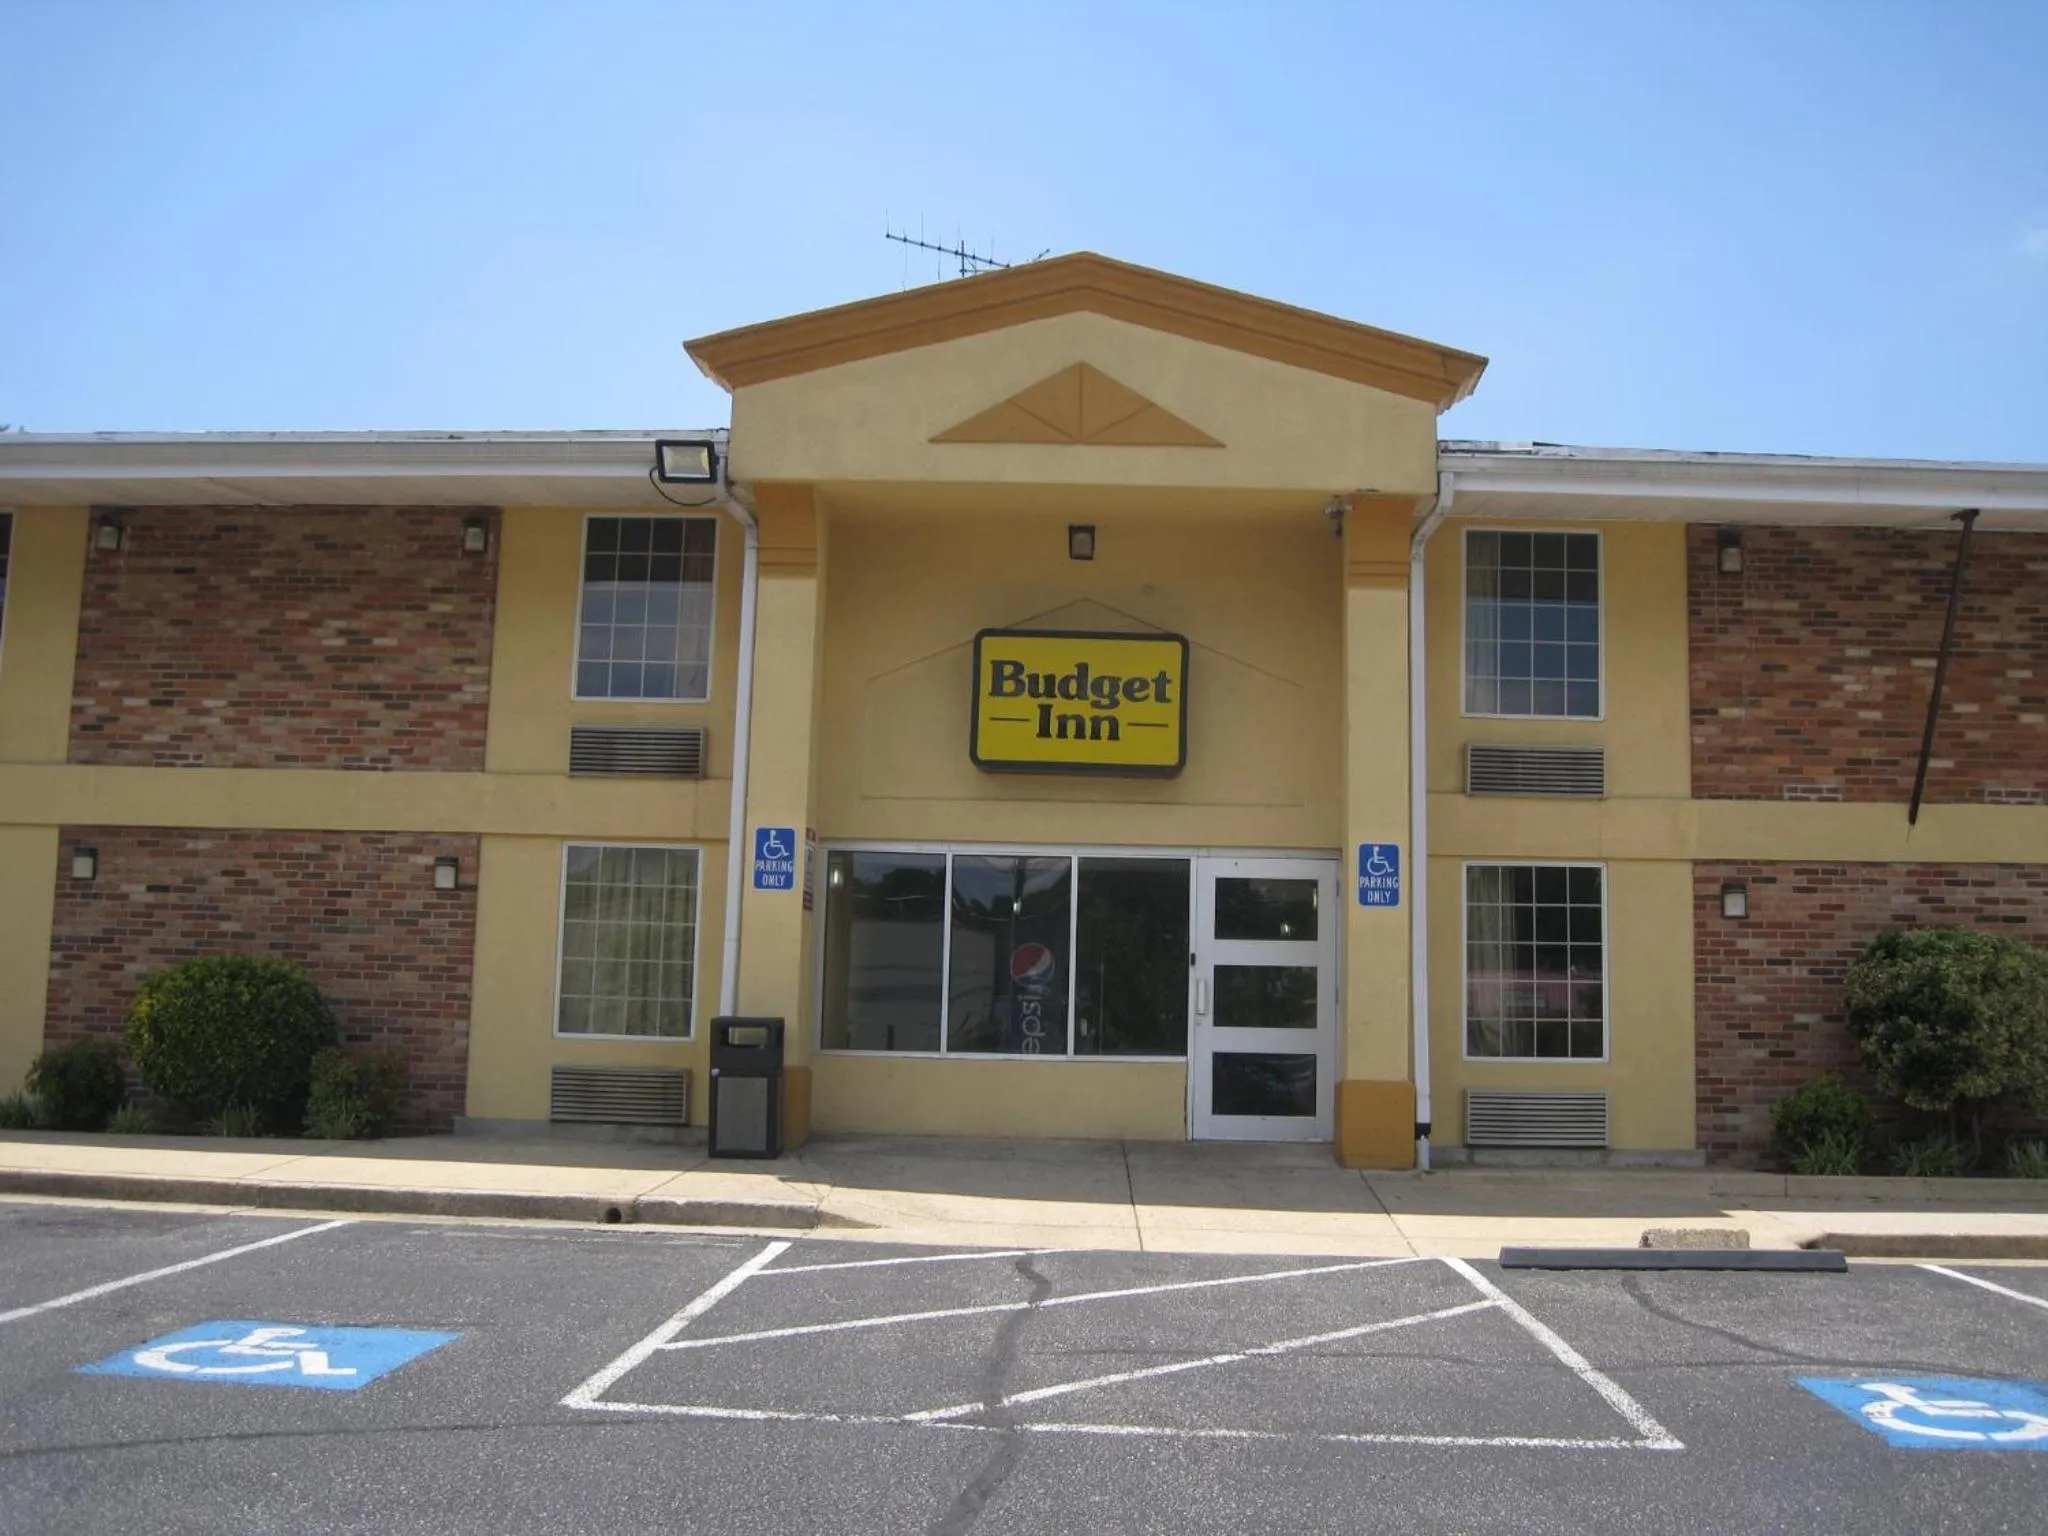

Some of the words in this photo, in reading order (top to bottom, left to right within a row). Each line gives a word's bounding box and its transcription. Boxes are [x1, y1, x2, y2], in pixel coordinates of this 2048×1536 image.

[988, 659, 1173, 710] Budget
[1036, 703, 1121, 741] Inn
[755, 859, 793, 873] PARKING
[762, 874, 786, 887] ONLY
[1360, 875, 1399, 889] PARKING
[1367, 890, 1391, 904] ONLY
[1017, 994, 1045, 1054] epsi
